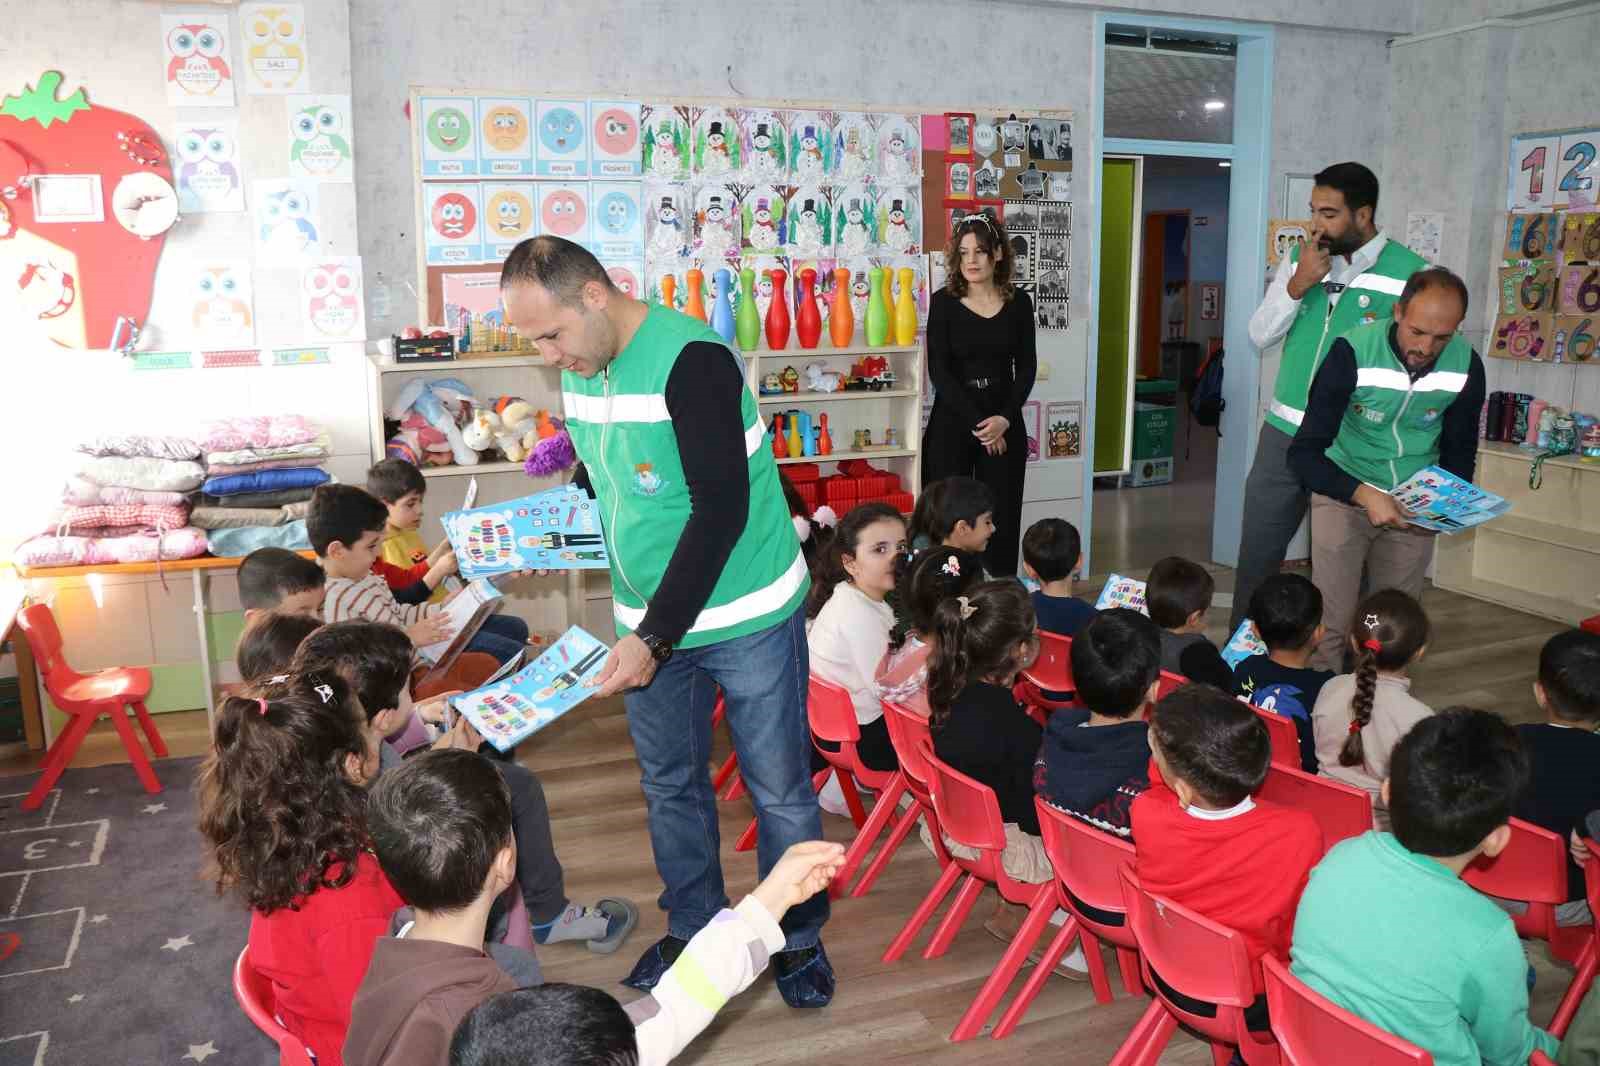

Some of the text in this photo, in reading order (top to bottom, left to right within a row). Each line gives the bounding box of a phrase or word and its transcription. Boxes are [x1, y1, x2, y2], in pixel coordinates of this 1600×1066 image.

[1521, 140, 1597, 193] 1 2
[1523, 214, 1546, 258] 6
[1567, 318, 1595, 361] 6
